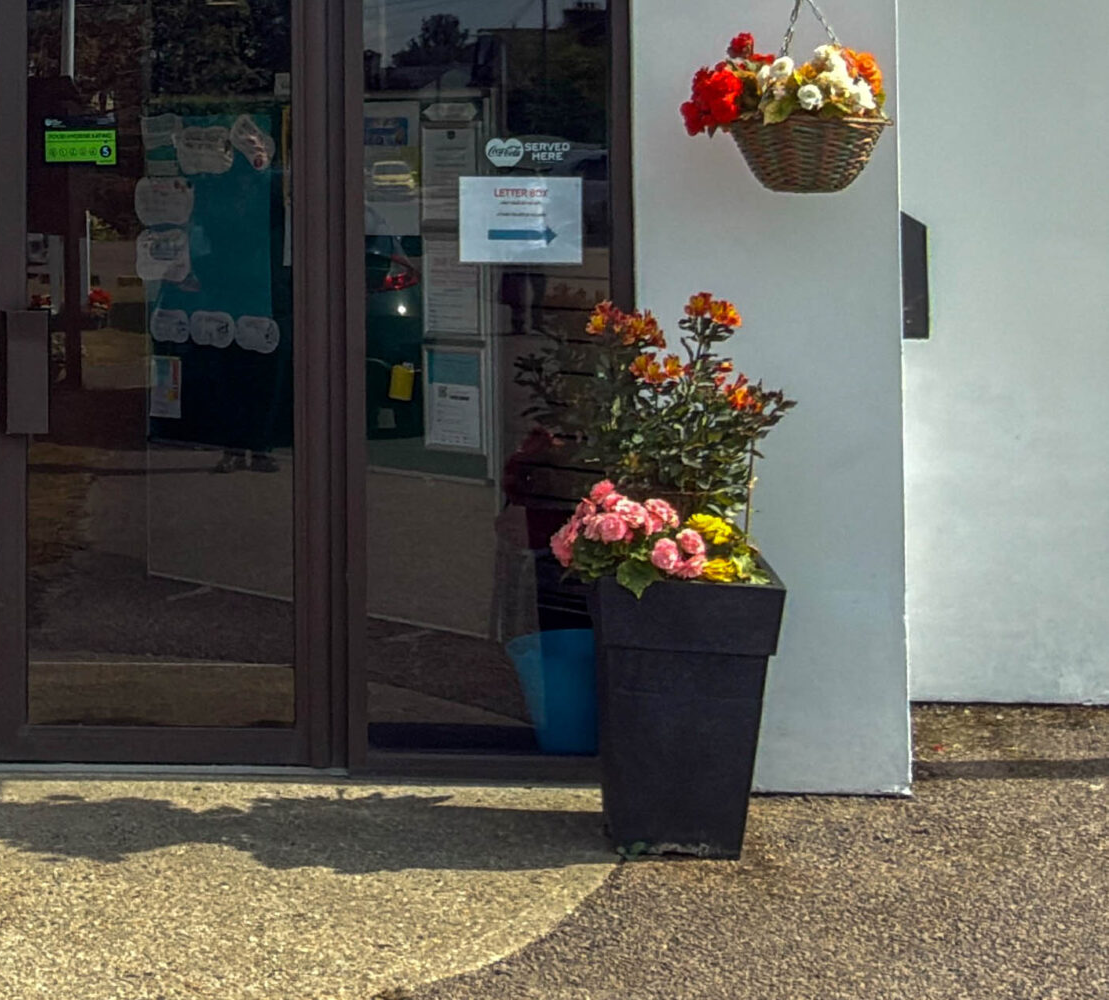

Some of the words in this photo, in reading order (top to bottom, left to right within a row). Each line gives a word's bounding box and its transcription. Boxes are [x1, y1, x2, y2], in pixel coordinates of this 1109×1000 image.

[524, 142, 570, 151] SERVED
[532, 152, 563, 160] HERE
[494, 188, 527, 198] LETTER
[529, 188, 548, 198] BOX
